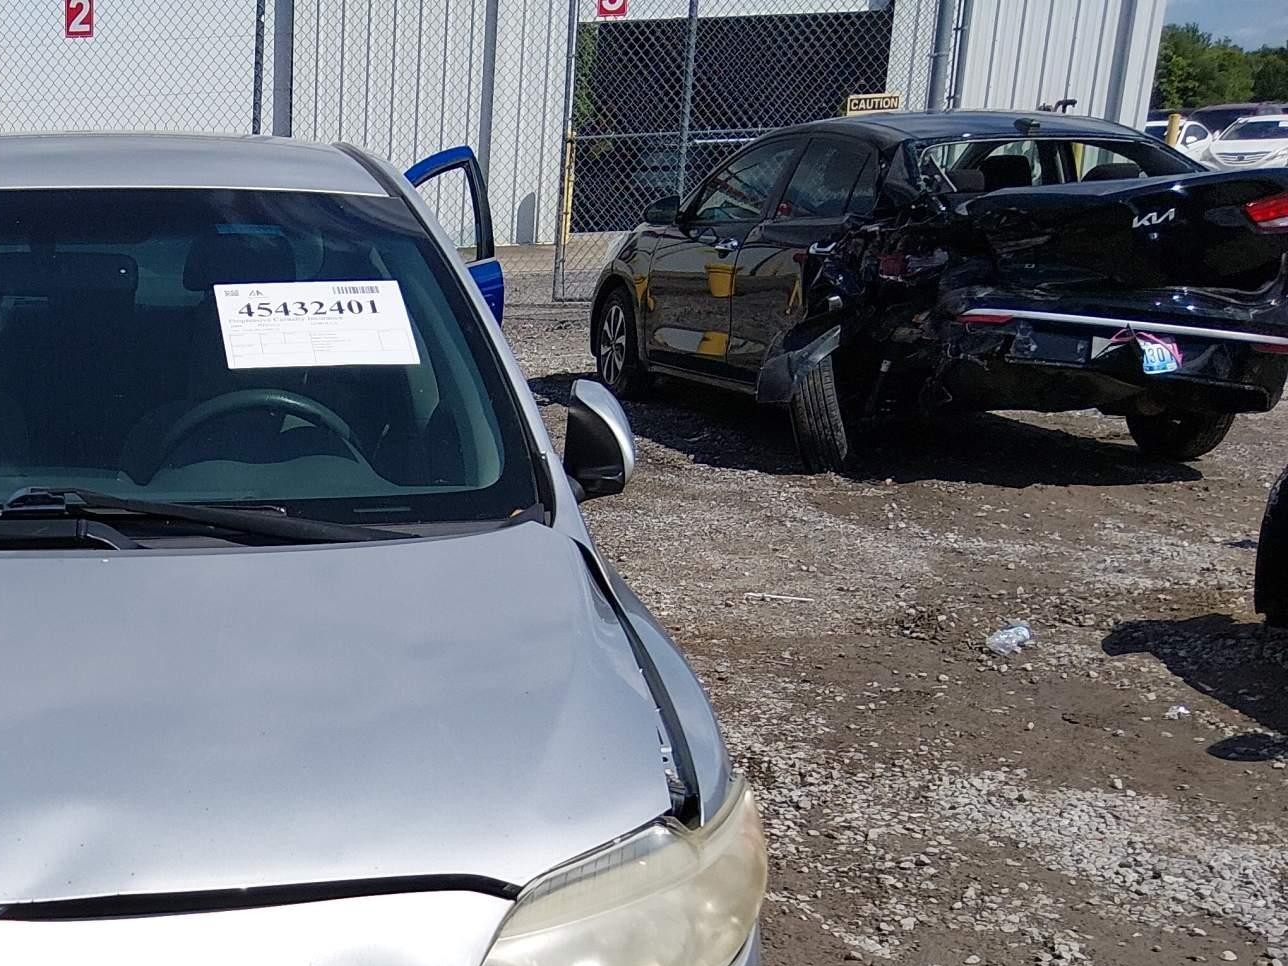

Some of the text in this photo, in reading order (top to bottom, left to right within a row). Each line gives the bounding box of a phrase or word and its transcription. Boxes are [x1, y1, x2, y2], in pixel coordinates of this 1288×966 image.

[69, 0, 90, 32] 2
[850, 97, 899, 110] CAUTION
[1132, 208, 1176, 228] KIA
[238, 299, 381, 317] 45432401
